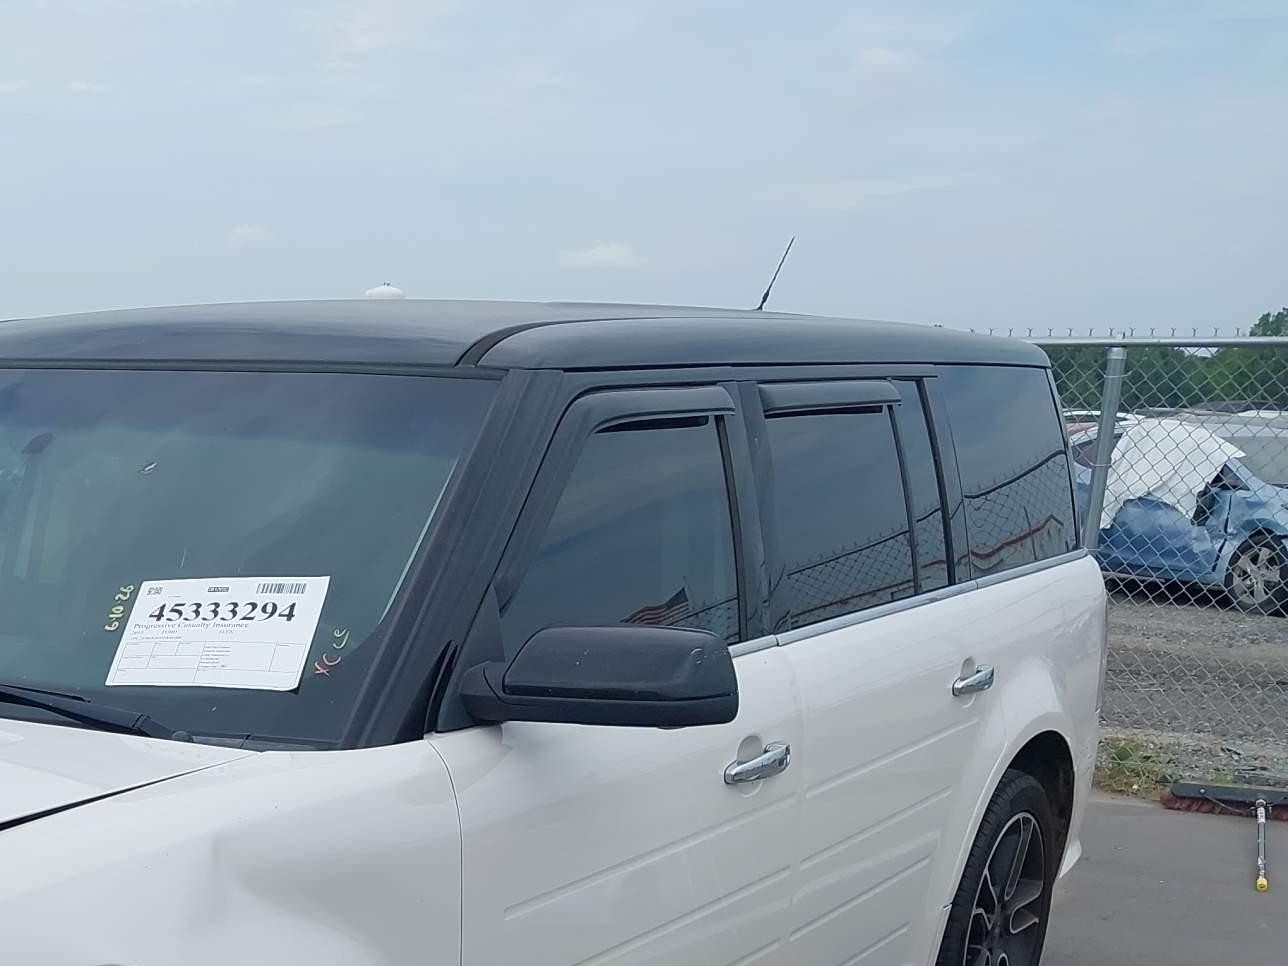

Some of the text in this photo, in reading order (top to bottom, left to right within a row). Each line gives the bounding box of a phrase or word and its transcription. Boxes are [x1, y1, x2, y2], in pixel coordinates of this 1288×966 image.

[148, 601, 296, 622] 45333294
[133, 622, 176, 631] Progressive
[177, 622, 211, 630] Casualty
